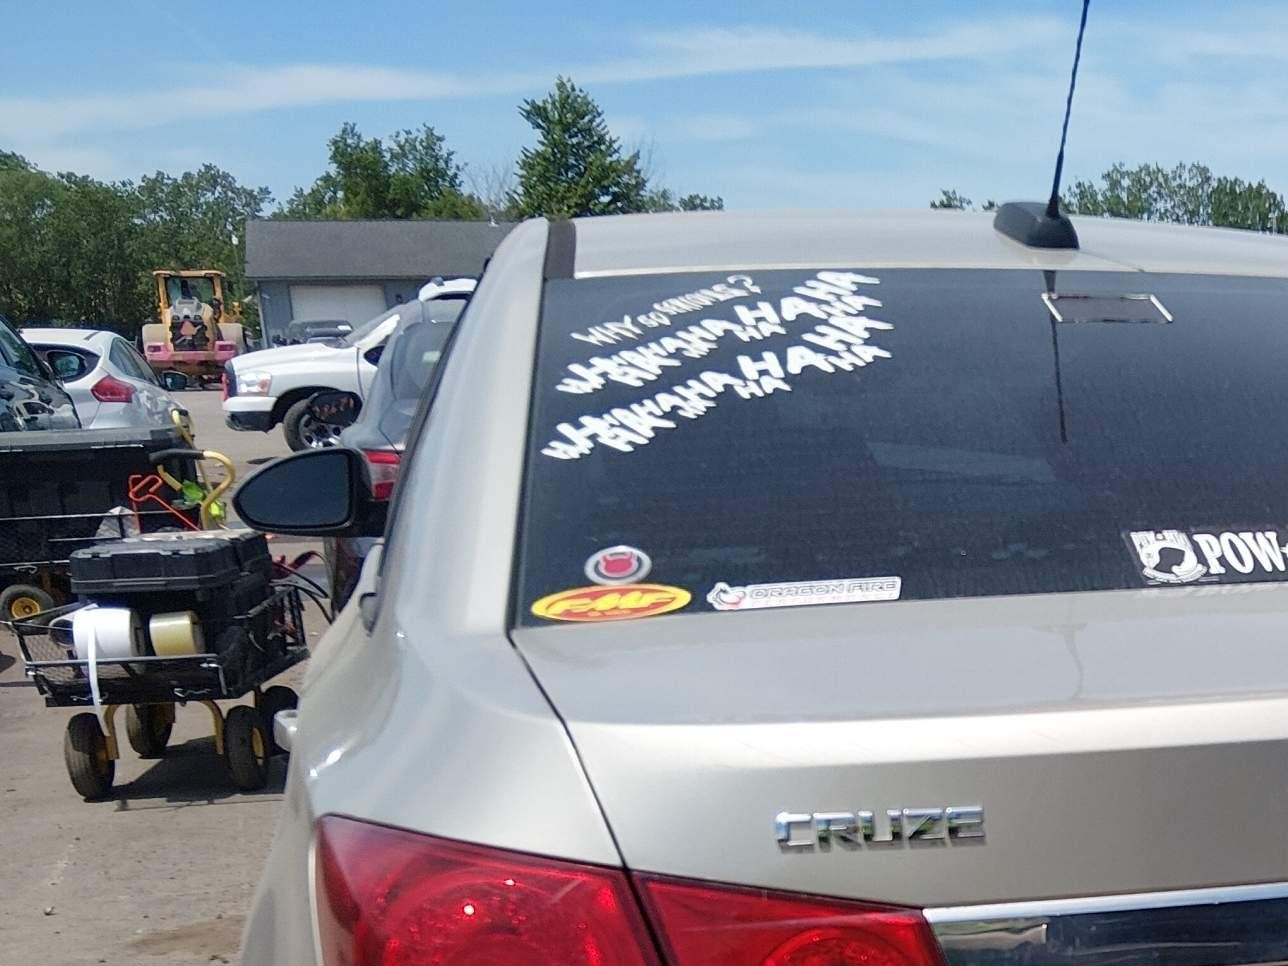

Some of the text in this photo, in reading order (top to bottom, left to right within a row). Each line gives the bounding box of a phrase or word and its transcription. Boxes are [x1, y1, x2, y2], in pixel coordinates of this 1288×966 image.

[570, 315, 645, 346] WHY
[637, 310, 671, 328] SO
[775, 805, 985, 850] CRUZE
